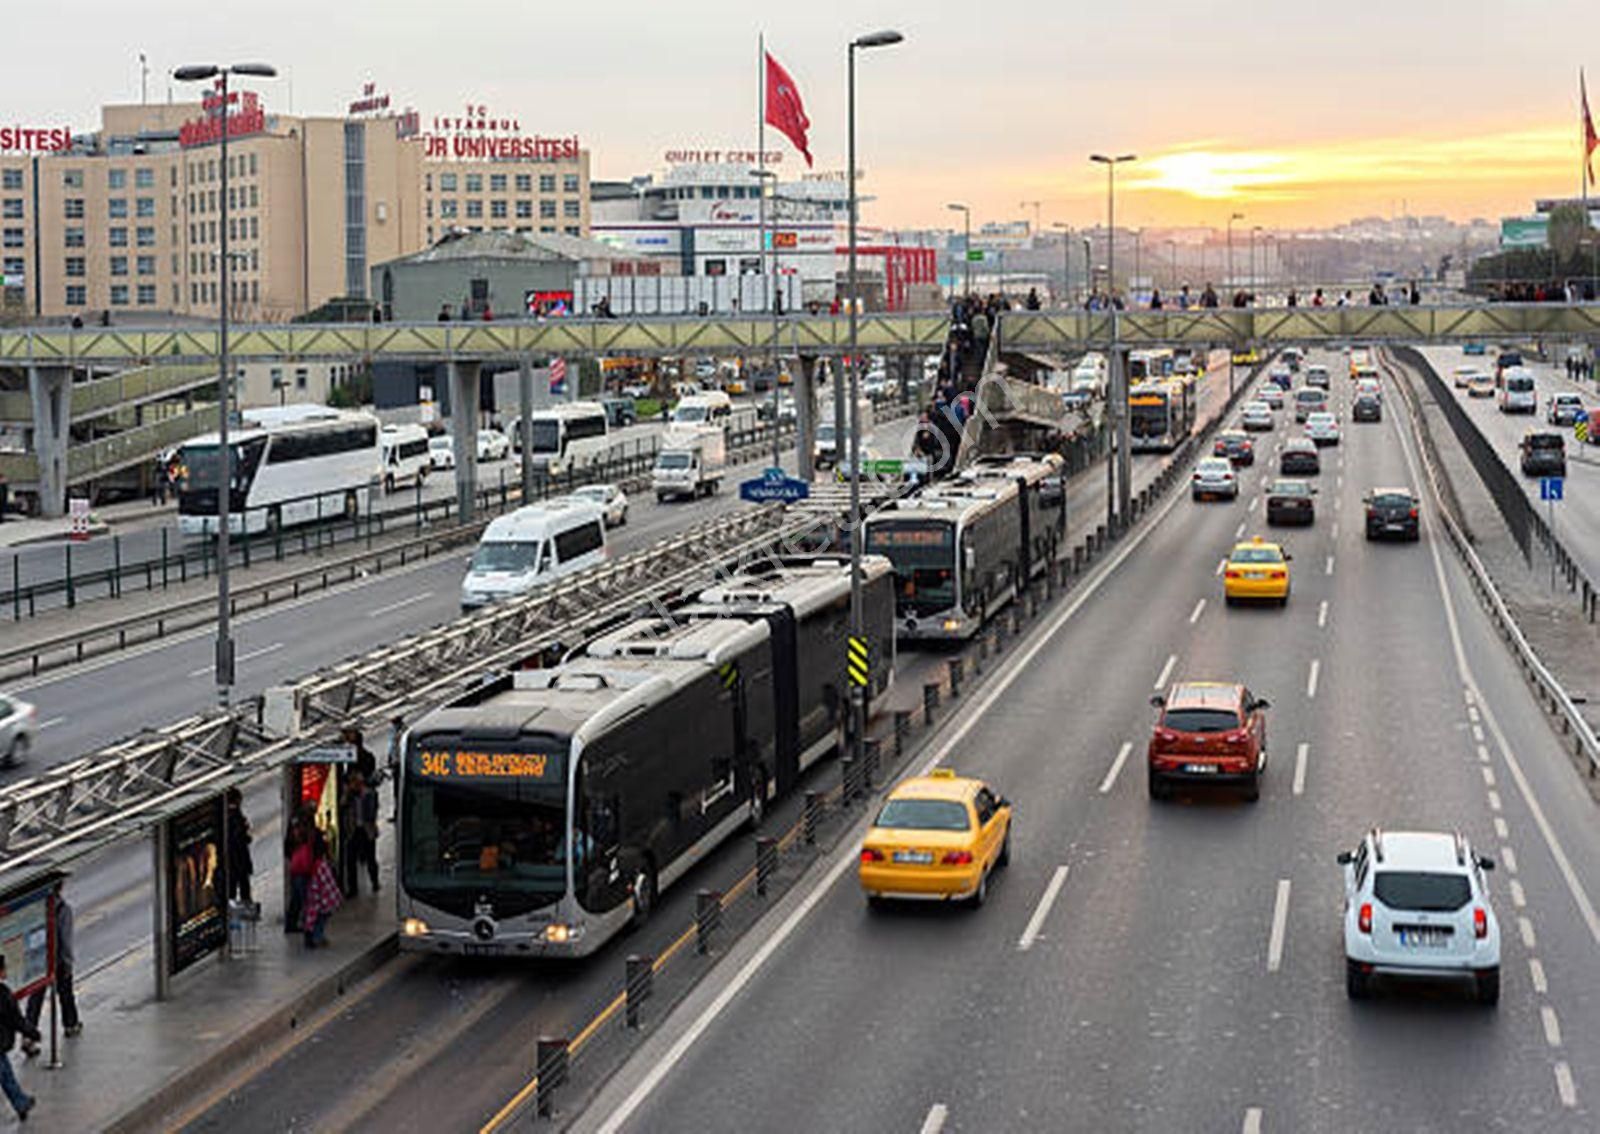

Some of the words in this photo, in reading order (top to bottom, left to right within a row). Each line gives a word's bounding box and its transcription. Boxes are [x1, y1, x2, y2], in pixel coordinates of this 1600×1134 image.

[665, 151, 720, 163] OUTLET
[726, 151, 783, 164] CENER
[421, 752, 450, 776] 34C
